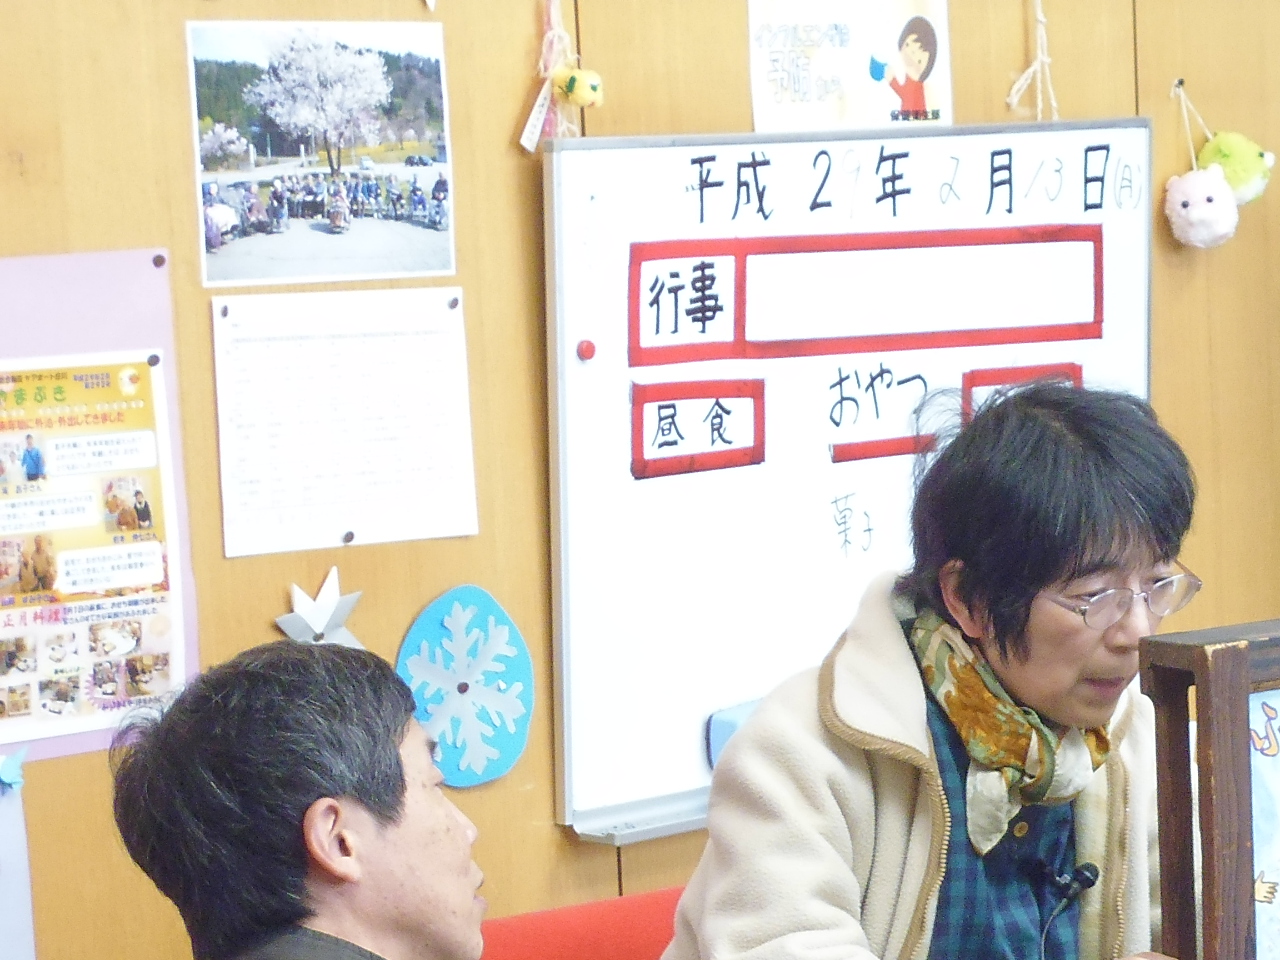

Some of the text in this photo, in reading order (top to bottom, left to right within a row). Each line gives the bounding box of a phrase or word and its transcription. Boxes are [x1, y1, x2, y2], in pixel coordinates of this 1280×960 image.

[648, 260, 724, 335] 行事
[651, 398, 734, 448] 昼食
[829, 362, 928, 427] おやつ
[830, 492, 875, 557] 菓子
